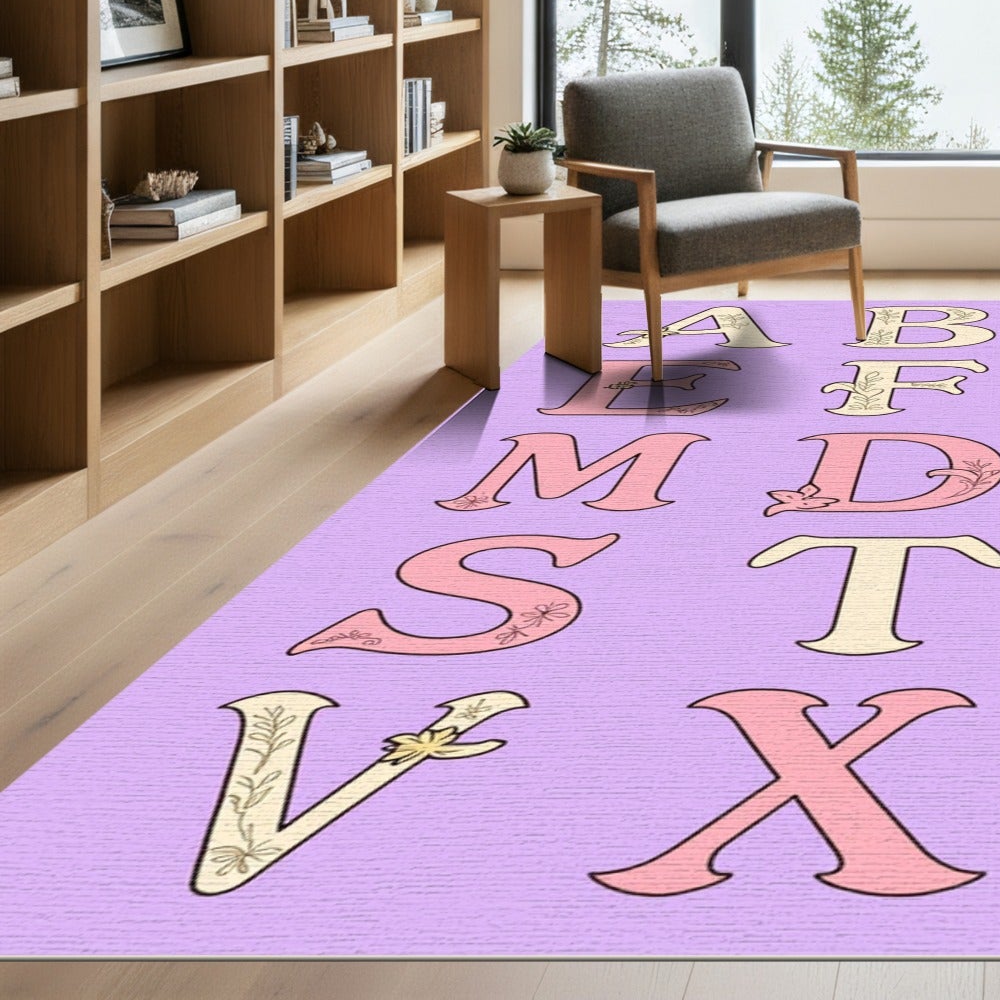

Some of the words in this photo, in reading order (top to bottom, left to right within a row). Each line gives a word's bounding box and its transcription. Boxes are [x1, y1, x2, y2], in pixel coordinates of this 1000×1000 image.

[603, 306, 792, 348] A
[844, 305, 996, 348] B
[537, 360, 741, 416] E
[821, 360, 988, 416] F
[435, 432, 711, 512] M
[287, 533, 621, 656] S
[189, 690, 530, 896] V
[589, 688, 986, 897] X
